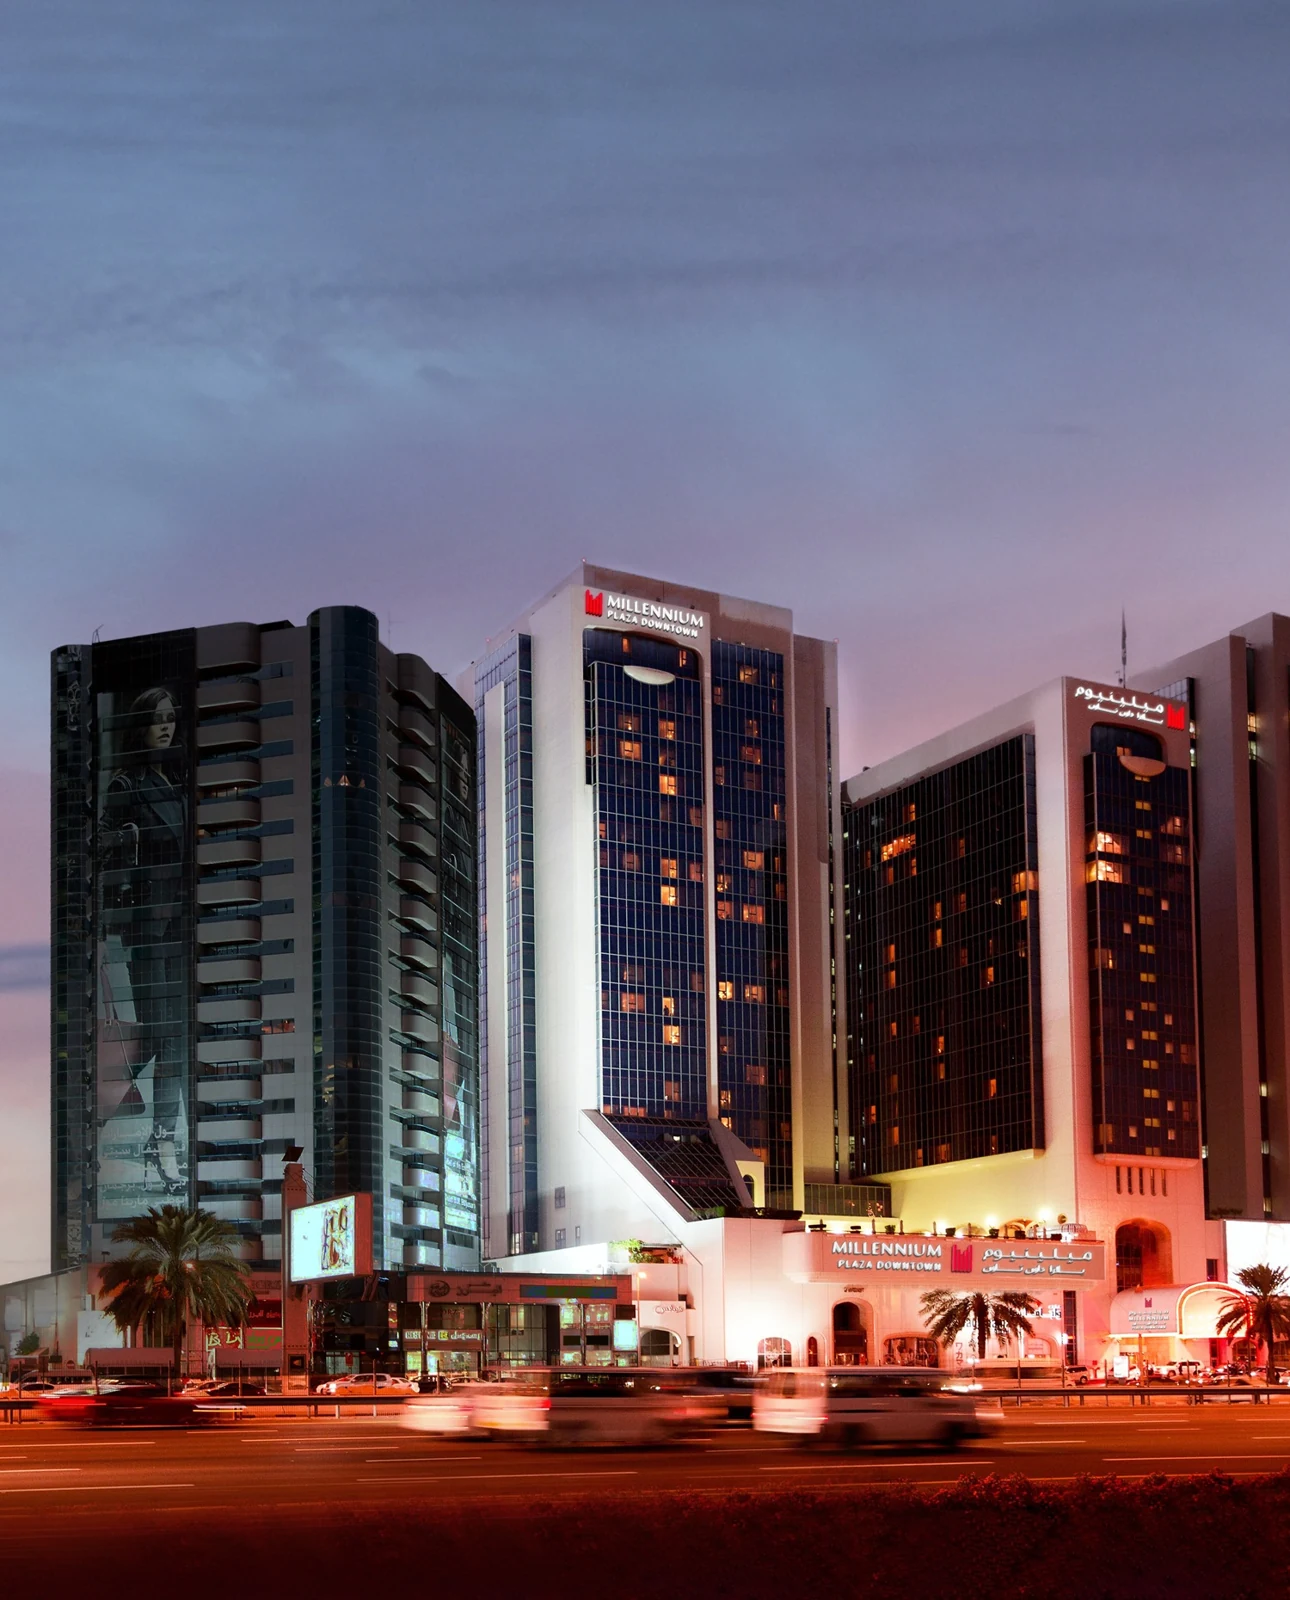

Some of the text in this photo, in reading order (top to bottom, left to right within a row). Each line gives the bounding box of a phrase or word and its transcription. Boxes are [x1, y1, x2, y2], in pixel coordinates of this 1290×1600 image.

[607, 595, 704, 628] MILLENNIUM
[607, 610, 698, 638] PLAZA DOWNTOWN
[832, 1241, 942, 1257] MILLENNIUM
[837, 1260, 941, 1271] PLAZA DOWNTOWN
